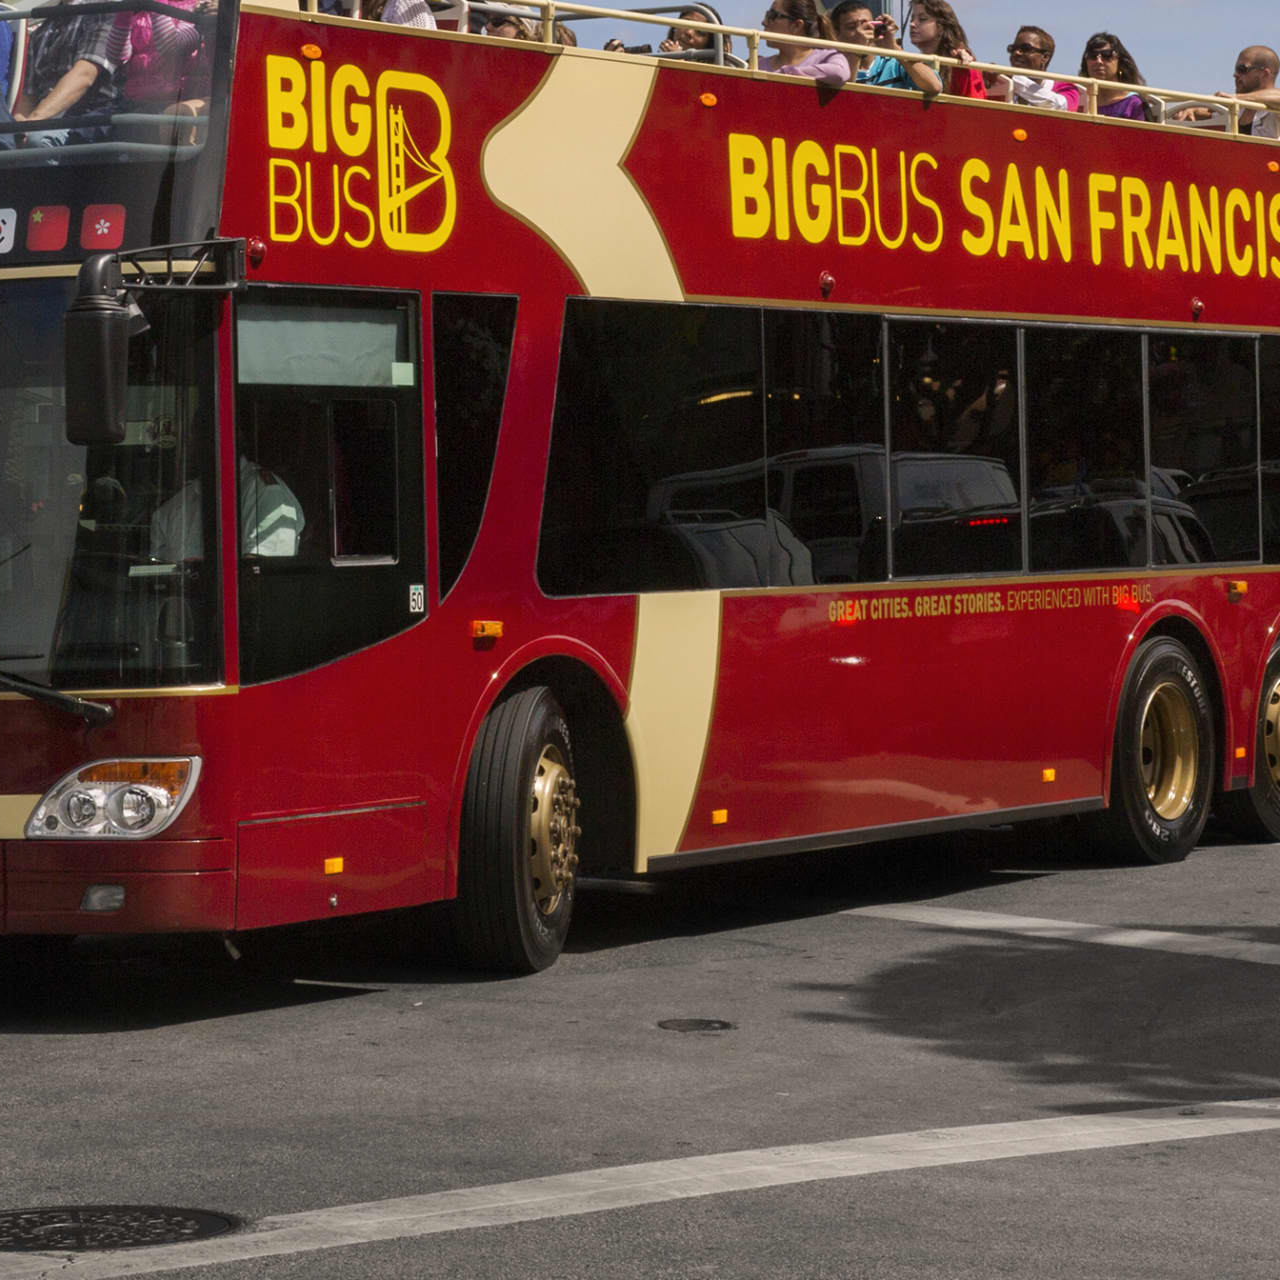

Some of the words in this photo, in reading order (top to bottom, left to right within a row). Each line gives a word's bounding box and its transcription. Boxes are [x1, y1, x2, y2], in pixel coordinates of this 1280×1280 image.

[266, 53, 373, 157] BIG
[269, 157, 375, 249] BUS
[958, 157, 1073, 264] SAN
[411, 591, 423, 610] 50
[828, 599, 869, 622] GREAT
[870, 596, 913, 620] CITIES.
[915, 593, 953, 618] GREAT
[954, 591, 1005, 615] STORIES.
[1007, 587, 1082, 612] EXPERIENCED
[1083, 586, 1110, 607] WITH
[1111, 584, 1130, 605] BIG
[1131, 583, 1155, 605] BUS.
